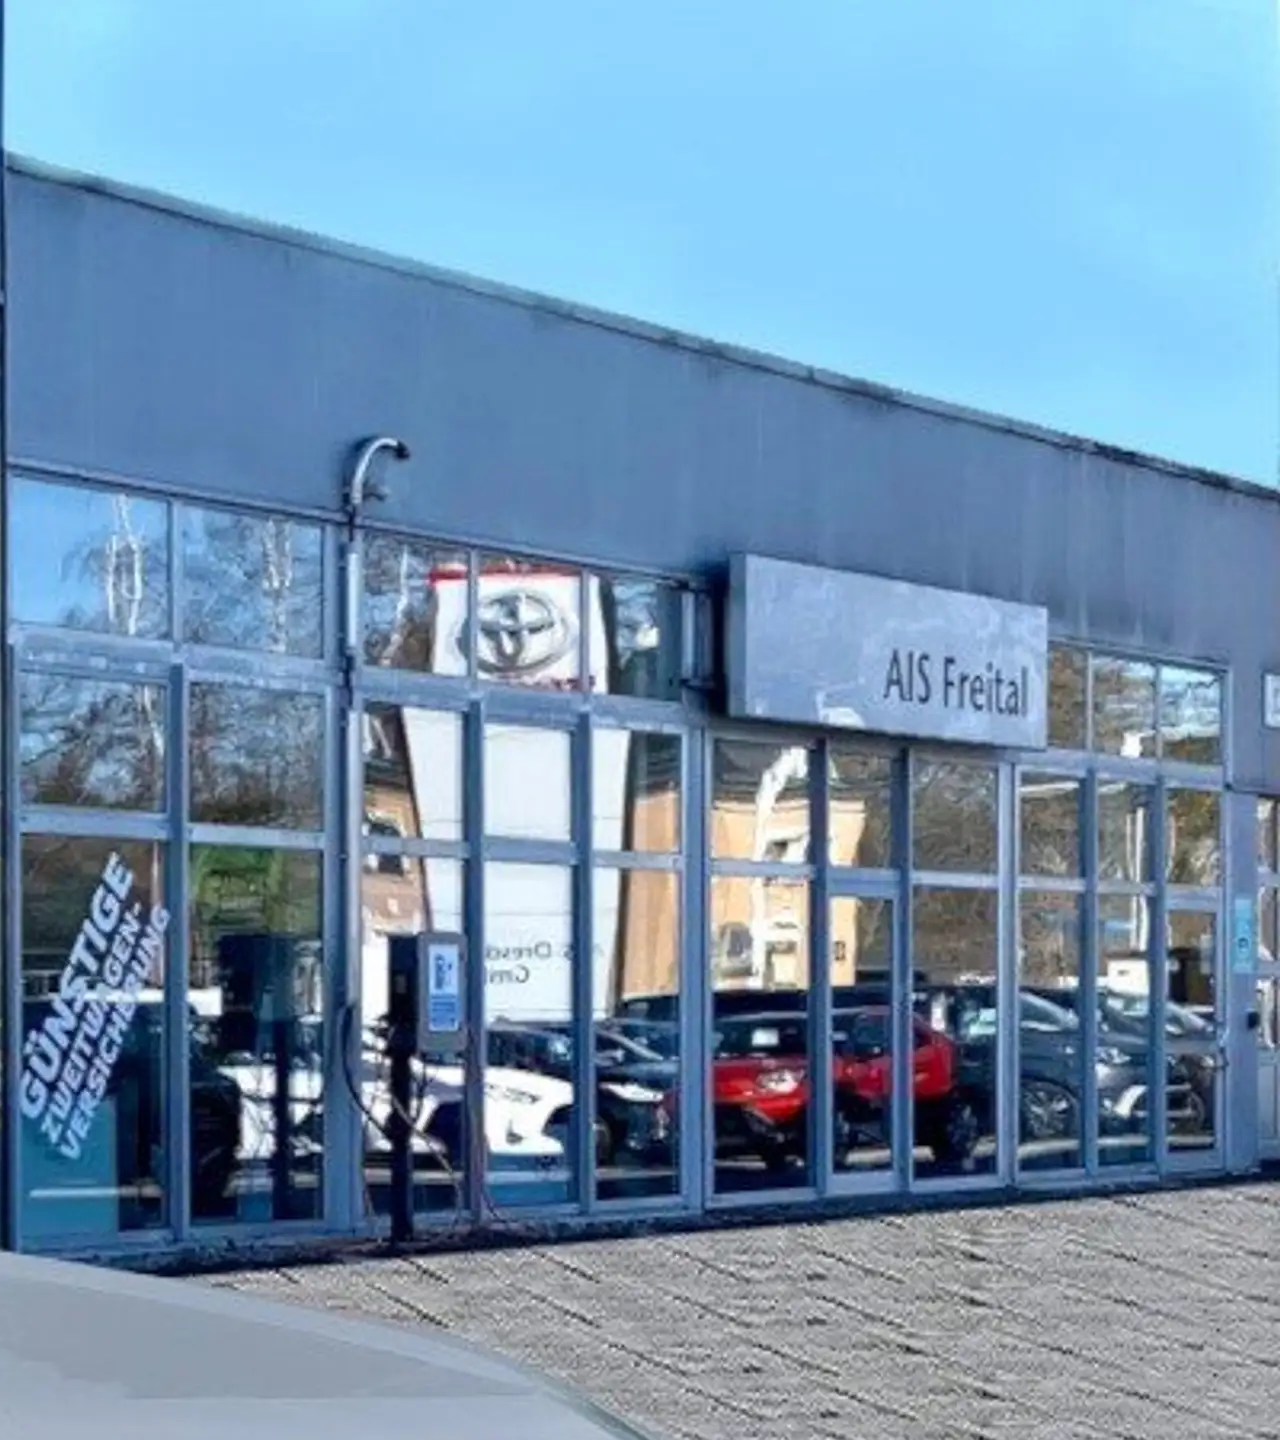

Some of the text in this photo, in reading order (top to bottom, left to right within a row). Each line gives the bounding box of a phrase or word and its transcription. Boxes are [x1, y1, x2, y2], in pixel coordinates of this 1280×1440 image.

[884, 649, 1028, 717] AIS Freital
[19, 851, 134, 1119] GÜNSTIGE
[59, 904, 171, 1159] VERSICHERUNG
